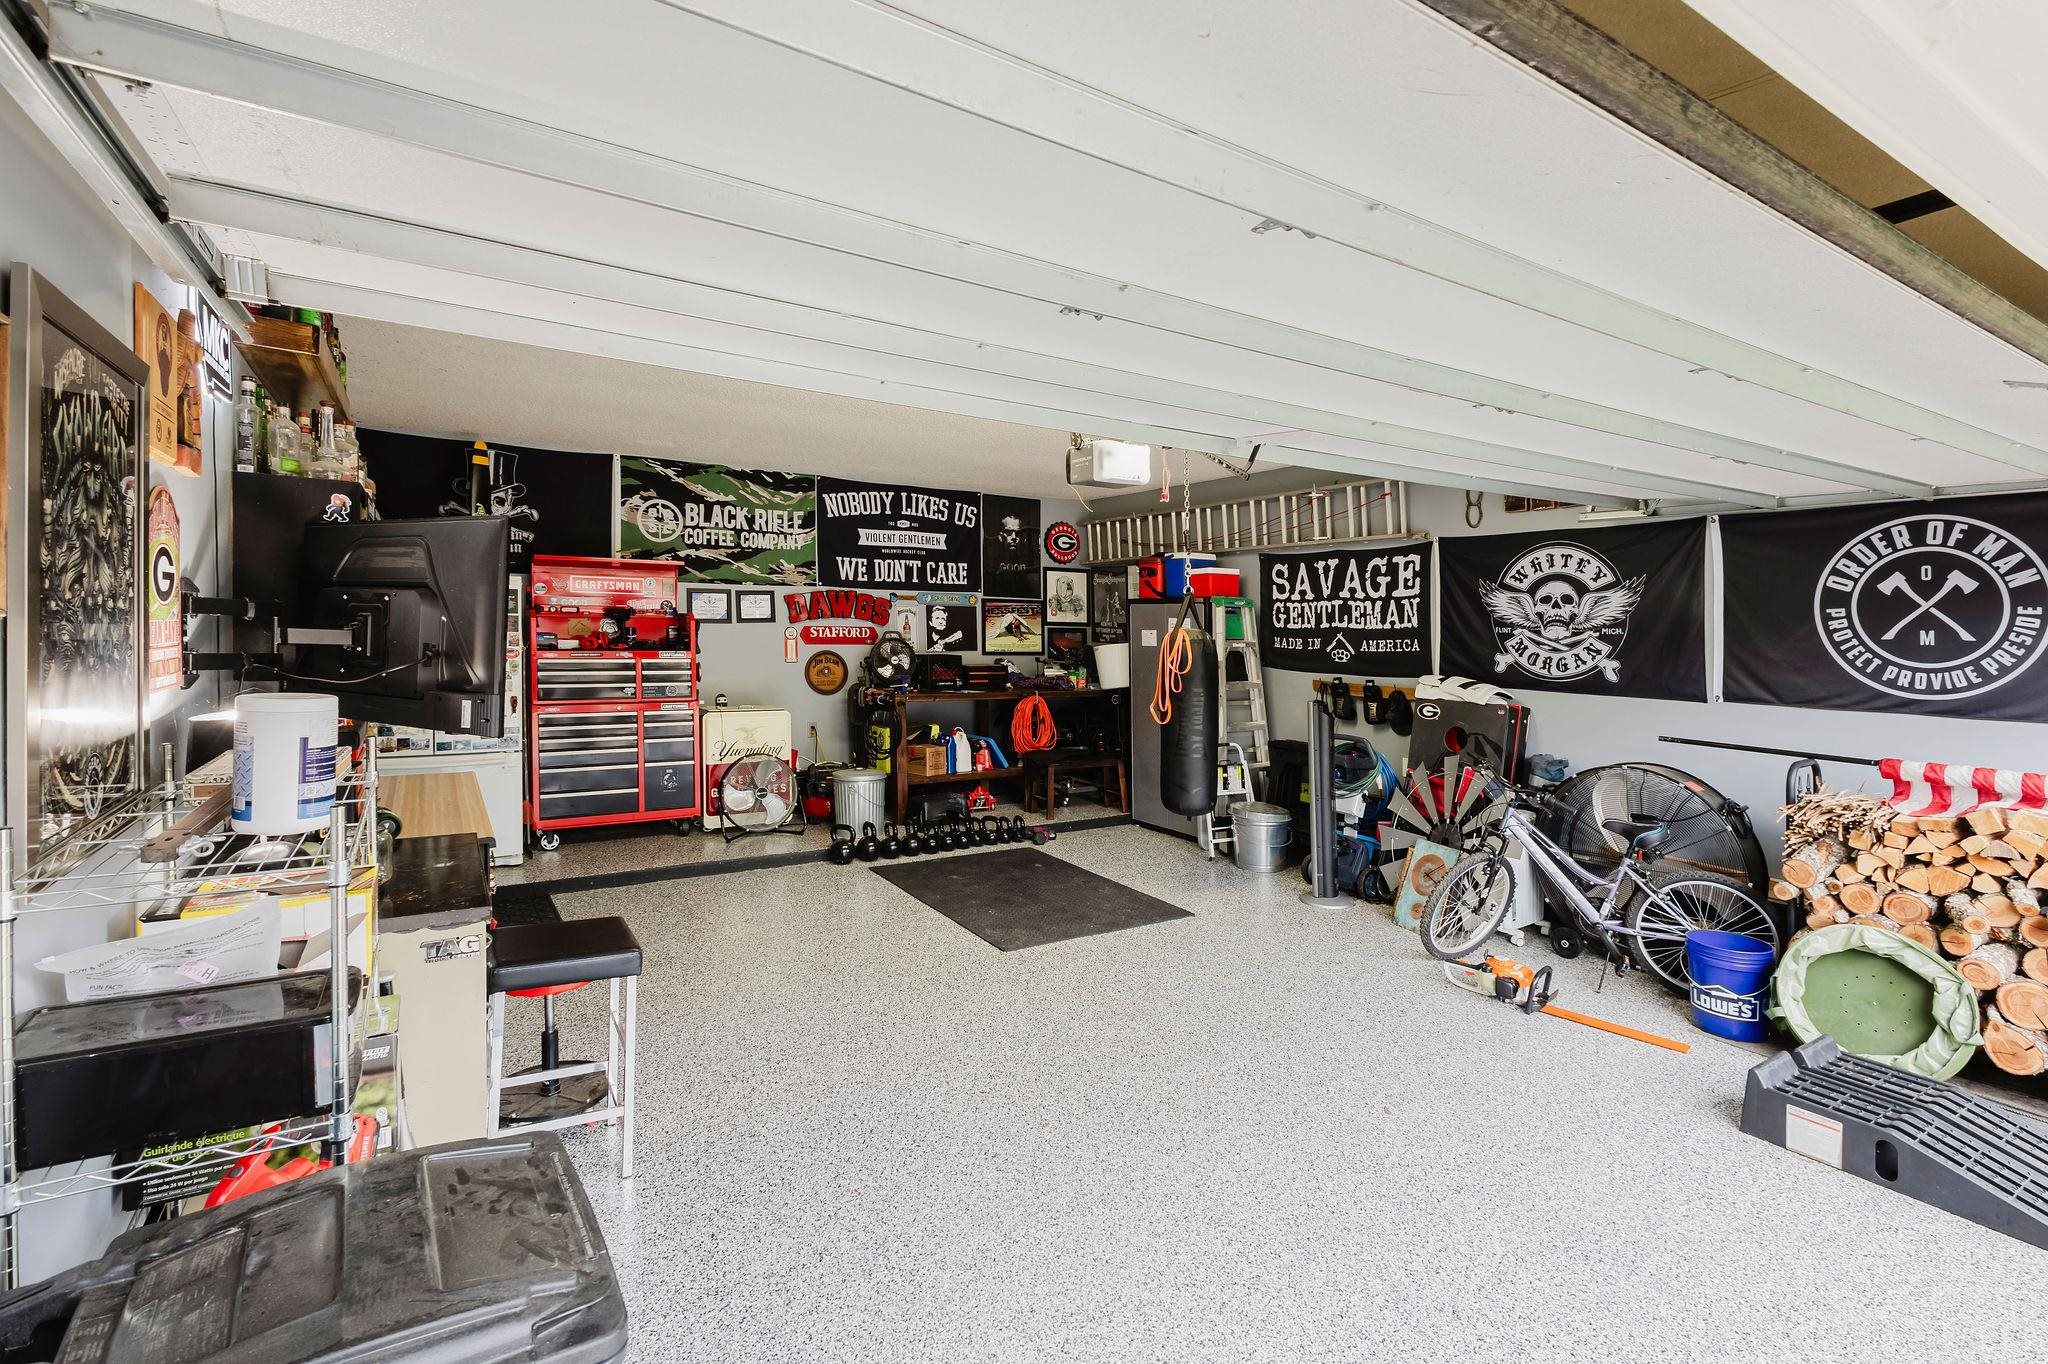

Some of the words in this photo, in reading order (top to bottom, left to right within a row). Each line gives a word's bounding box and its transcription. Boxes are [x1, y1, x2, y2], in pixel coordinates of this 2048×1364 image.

[685, 503, 749, 530] BLACK
[754, 508, 804, 533] RIFLE
[822, 491, 894, 518] NOBODY
[901, 492, 949, 521] LIKES
[954, 502, 978, 528] US
[684, 528, 735, 547] COFFEE
[740, 531, 806, 550] COMPANY
[865, 532, 896, 543] VIOLENT
[899, 534, 941, 546] GENTLEMEN
[1051, 527, 1078, 538] GEORGIA
[1508, 553, 1608, 584] WHITEY
[1825, 524, 1913, 593] ORDER
[1925, 520, 1968, 547] OF
[1971, 532, 2041, 589] MAN
[153, 546, 176, 602] G
[836, 556, 868, 581] WE
[874, 559, 921, 583] DON'T
[926, 561, 968, 585] CARE
[1271, 553, 1421, 600] SAVAGE
[1920, 565, 1932, 581] O
[576, 579, 640, 591] CRAFTSMAN
[784, 590, 892, 626] DAWGS
[1272, 597, 1421, 630] GENTLEMAN
[810, 626, 870, 638] STAFFORD
[1495, 626, 1512, 634] FLINT
[1601, 627, 1624, 635] MICH.
[1919, 630, 1935, 646] M
[1273, 636, 1303, 650] MADE
[1307, 638, 1322, 650] IN
[1360, 638, 1420, 652] AMERICA
[1509, 637, 1603, 675] MORGAN
[1825, 607, 1883, 674] PROTECT
[1881, 664, 1983, 690] PROVIDE
[1980, 605, 2043, 676] PRESIDE
[824, 656, 840, 668] BEAM
[712, 740, 786, 761] Yuengling
[420, 935, 480, 959] TAG
[97, 955, 123, 968] WHERE
[1693, 988, 1752, 1018] LOWE'S
[143, 1142, 193, 1157] Guirlande
[195, 1131, 245, 1146] électrique
